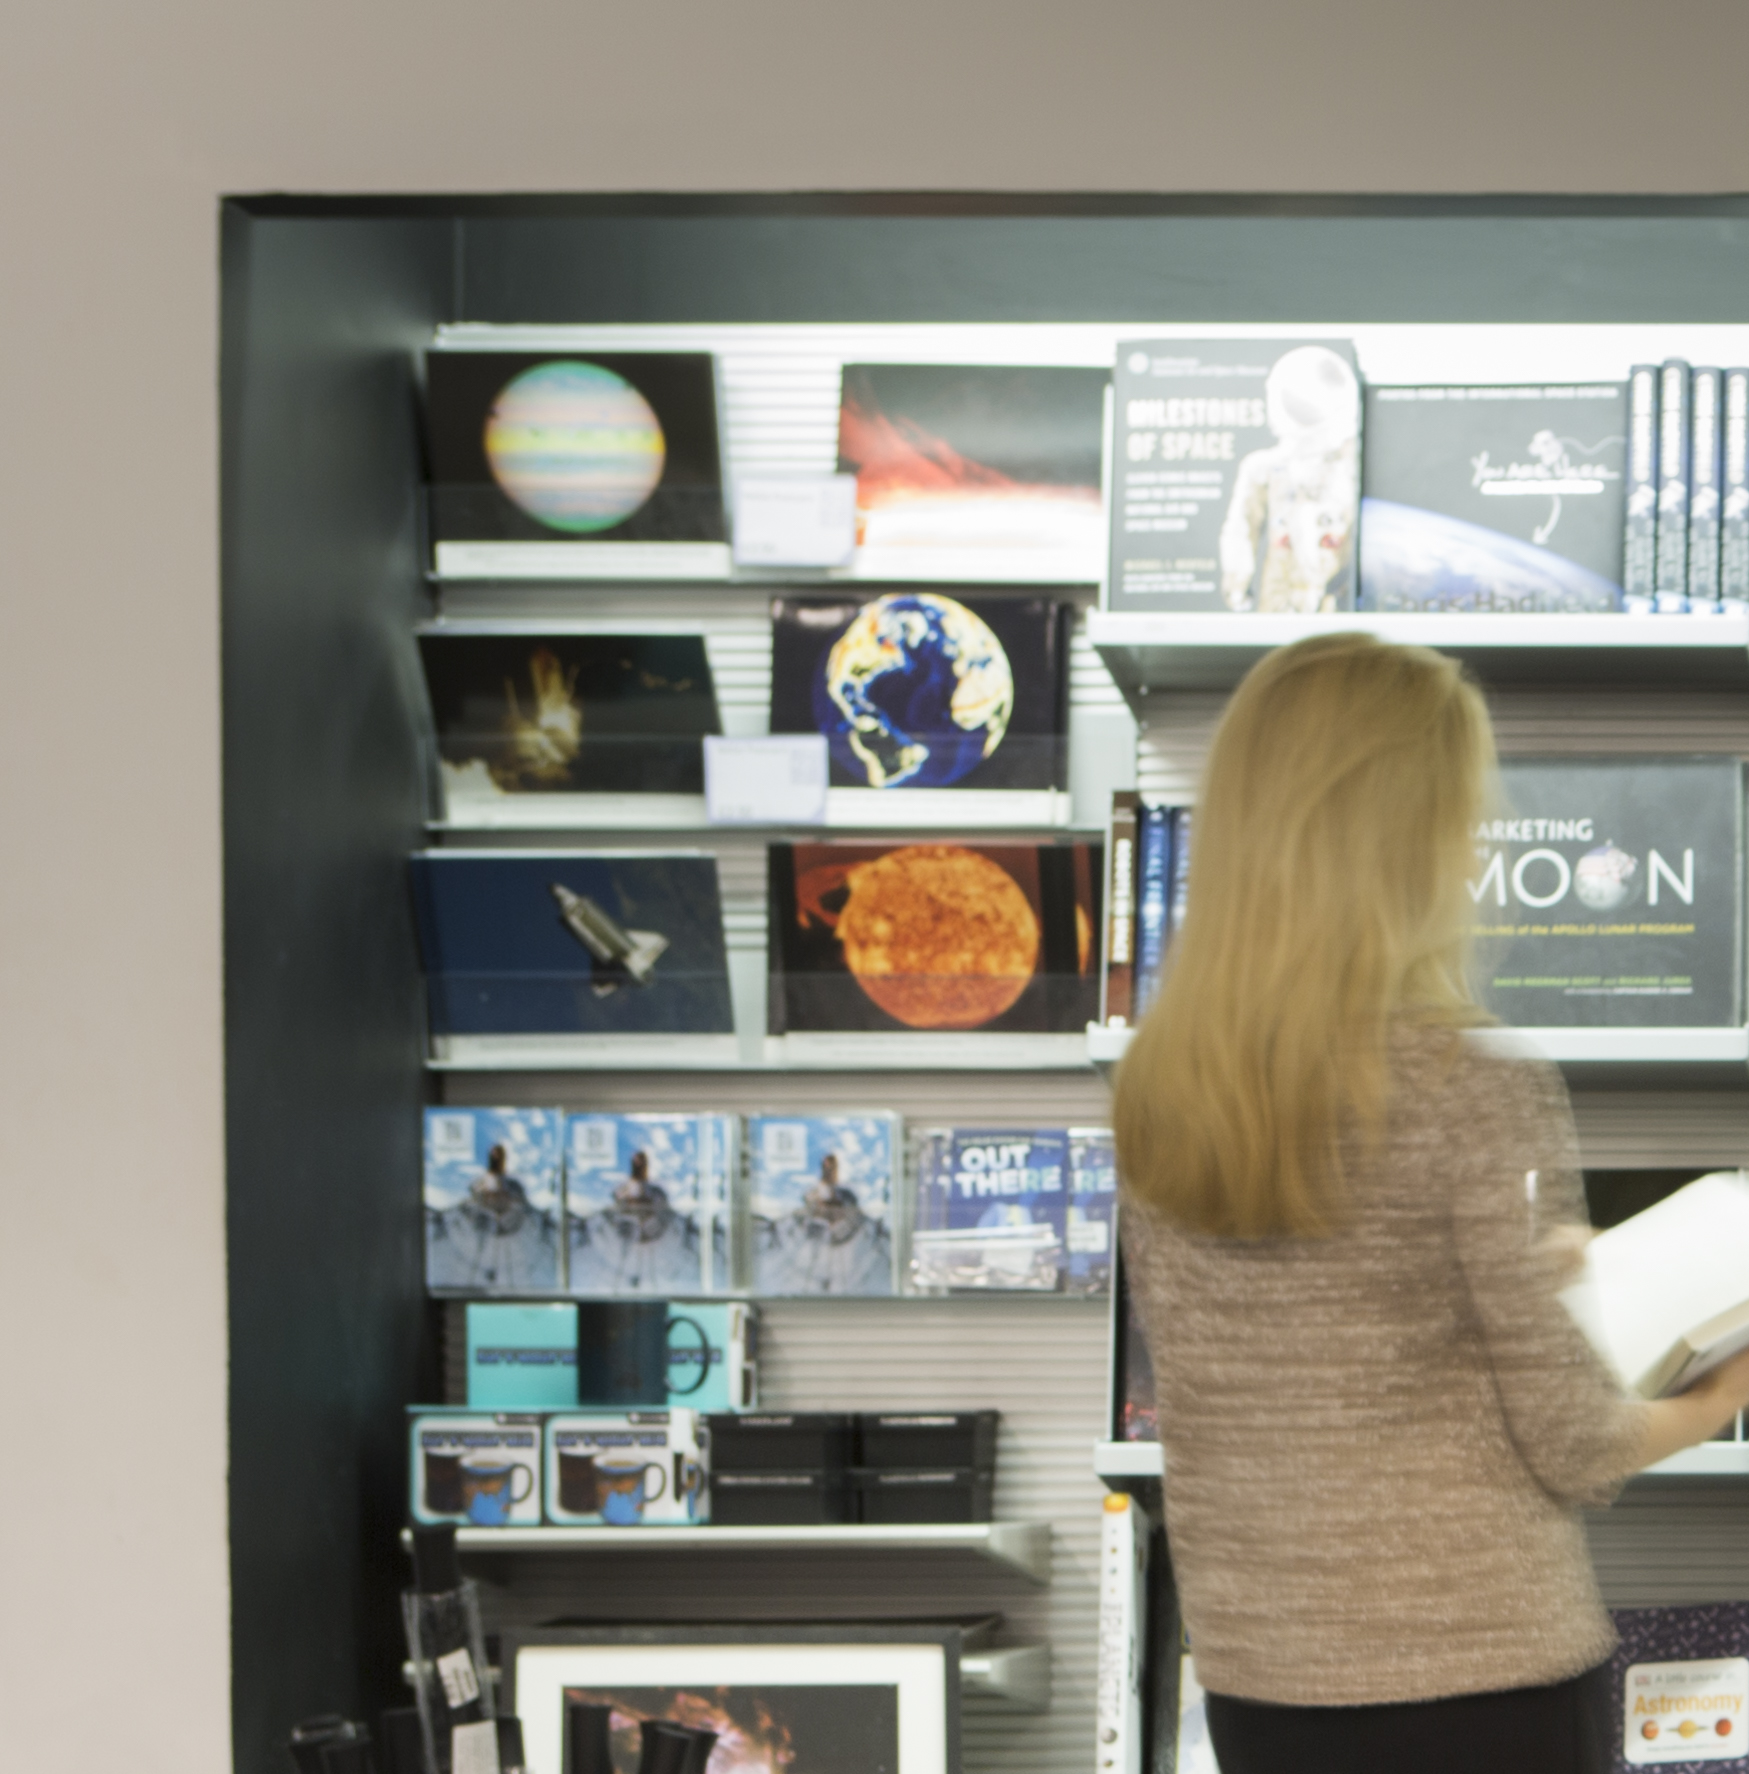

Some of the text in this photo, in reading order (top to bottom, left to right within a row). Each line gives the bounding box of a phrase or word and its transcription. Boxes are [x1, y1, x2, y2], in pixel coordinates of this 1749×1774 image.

[1127, 397, 1265, 428] MILESTONES
[1127, 431, 1236, 461] OF SPACE
[1468, 818, 1594, 842] ARKETING
[960, 1144, 1031, 1173] OUT
[954, 1165, 1062, 1198] THERE
[1632, 1690, 1744, 1719] Astronomy
